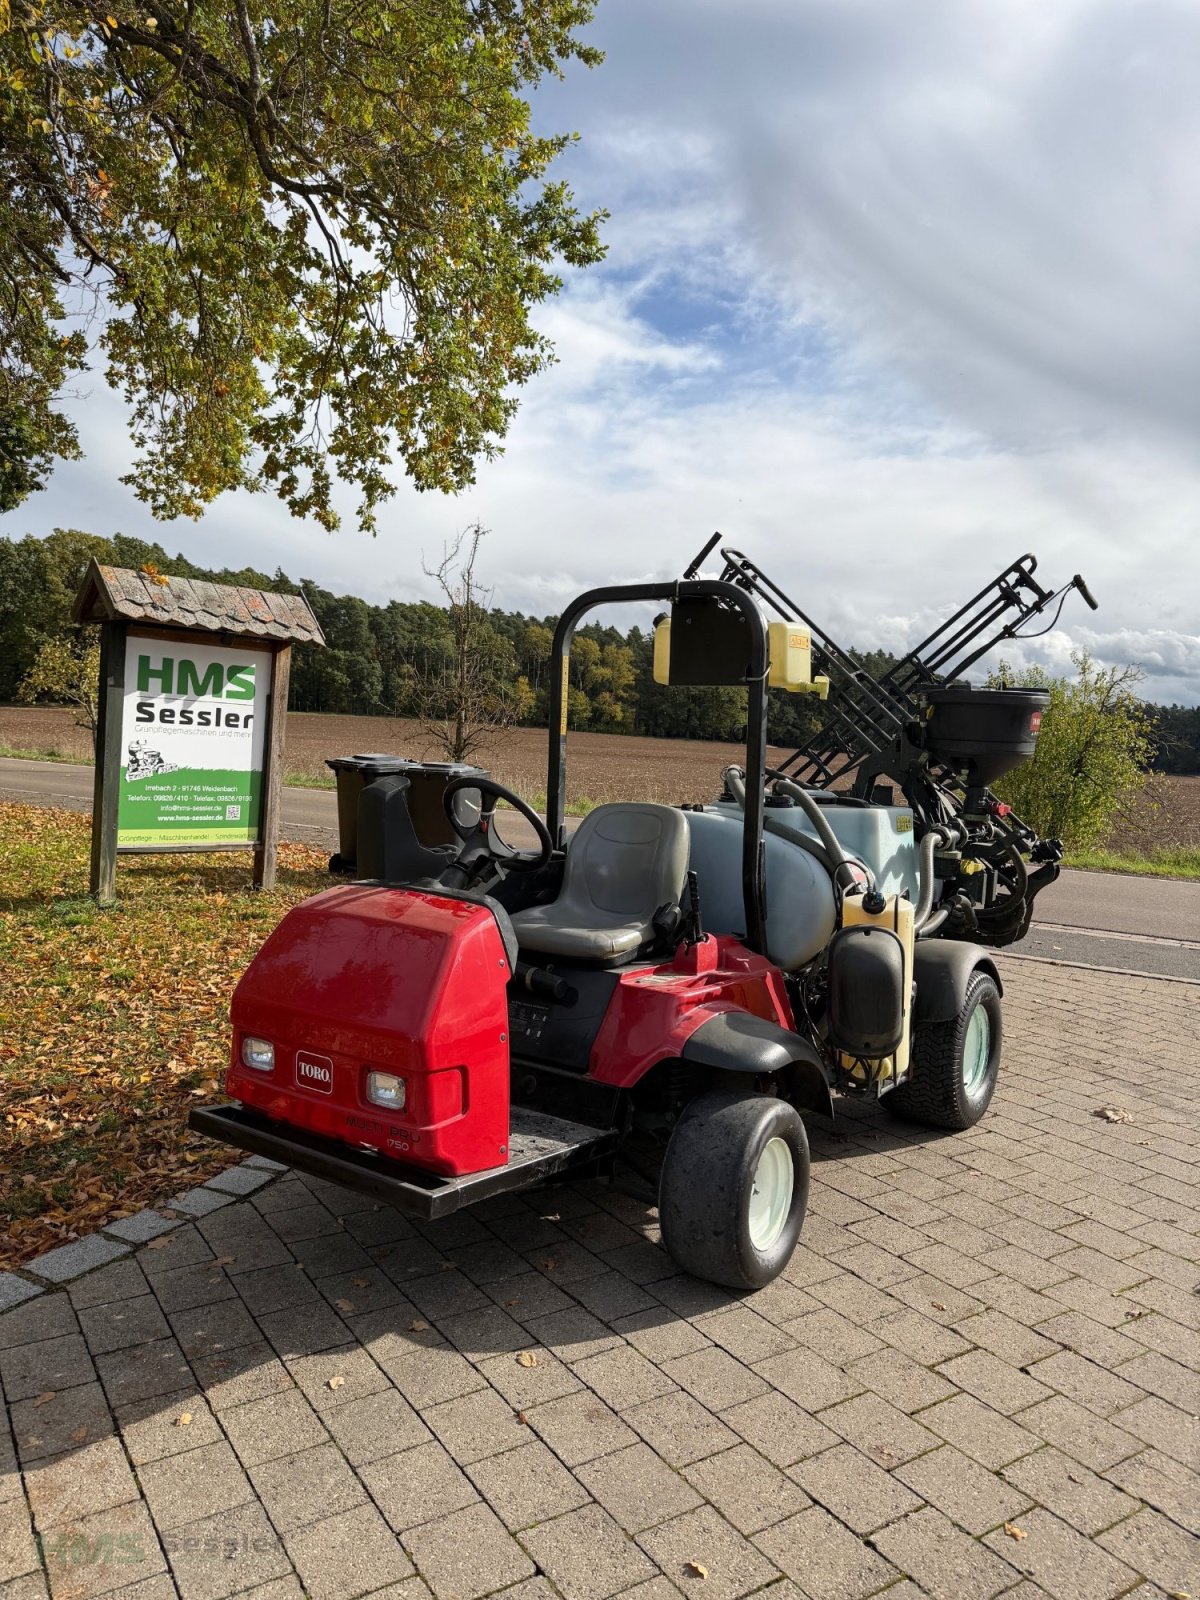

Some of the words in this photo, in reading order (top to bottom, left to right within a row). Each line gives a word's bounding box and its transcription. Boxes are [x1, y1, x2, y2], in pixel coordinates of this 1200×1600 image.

[137, 655, 256, 700] HMS
[136, 702, 254, 729] Sessler
[158, 833, 210, 841] Maschinenhandel
[299, 1061, 330, 1082] TORO
[346, 1115, 383, 1134] MULTI
[390, 1126, 421, 1142] PRO
